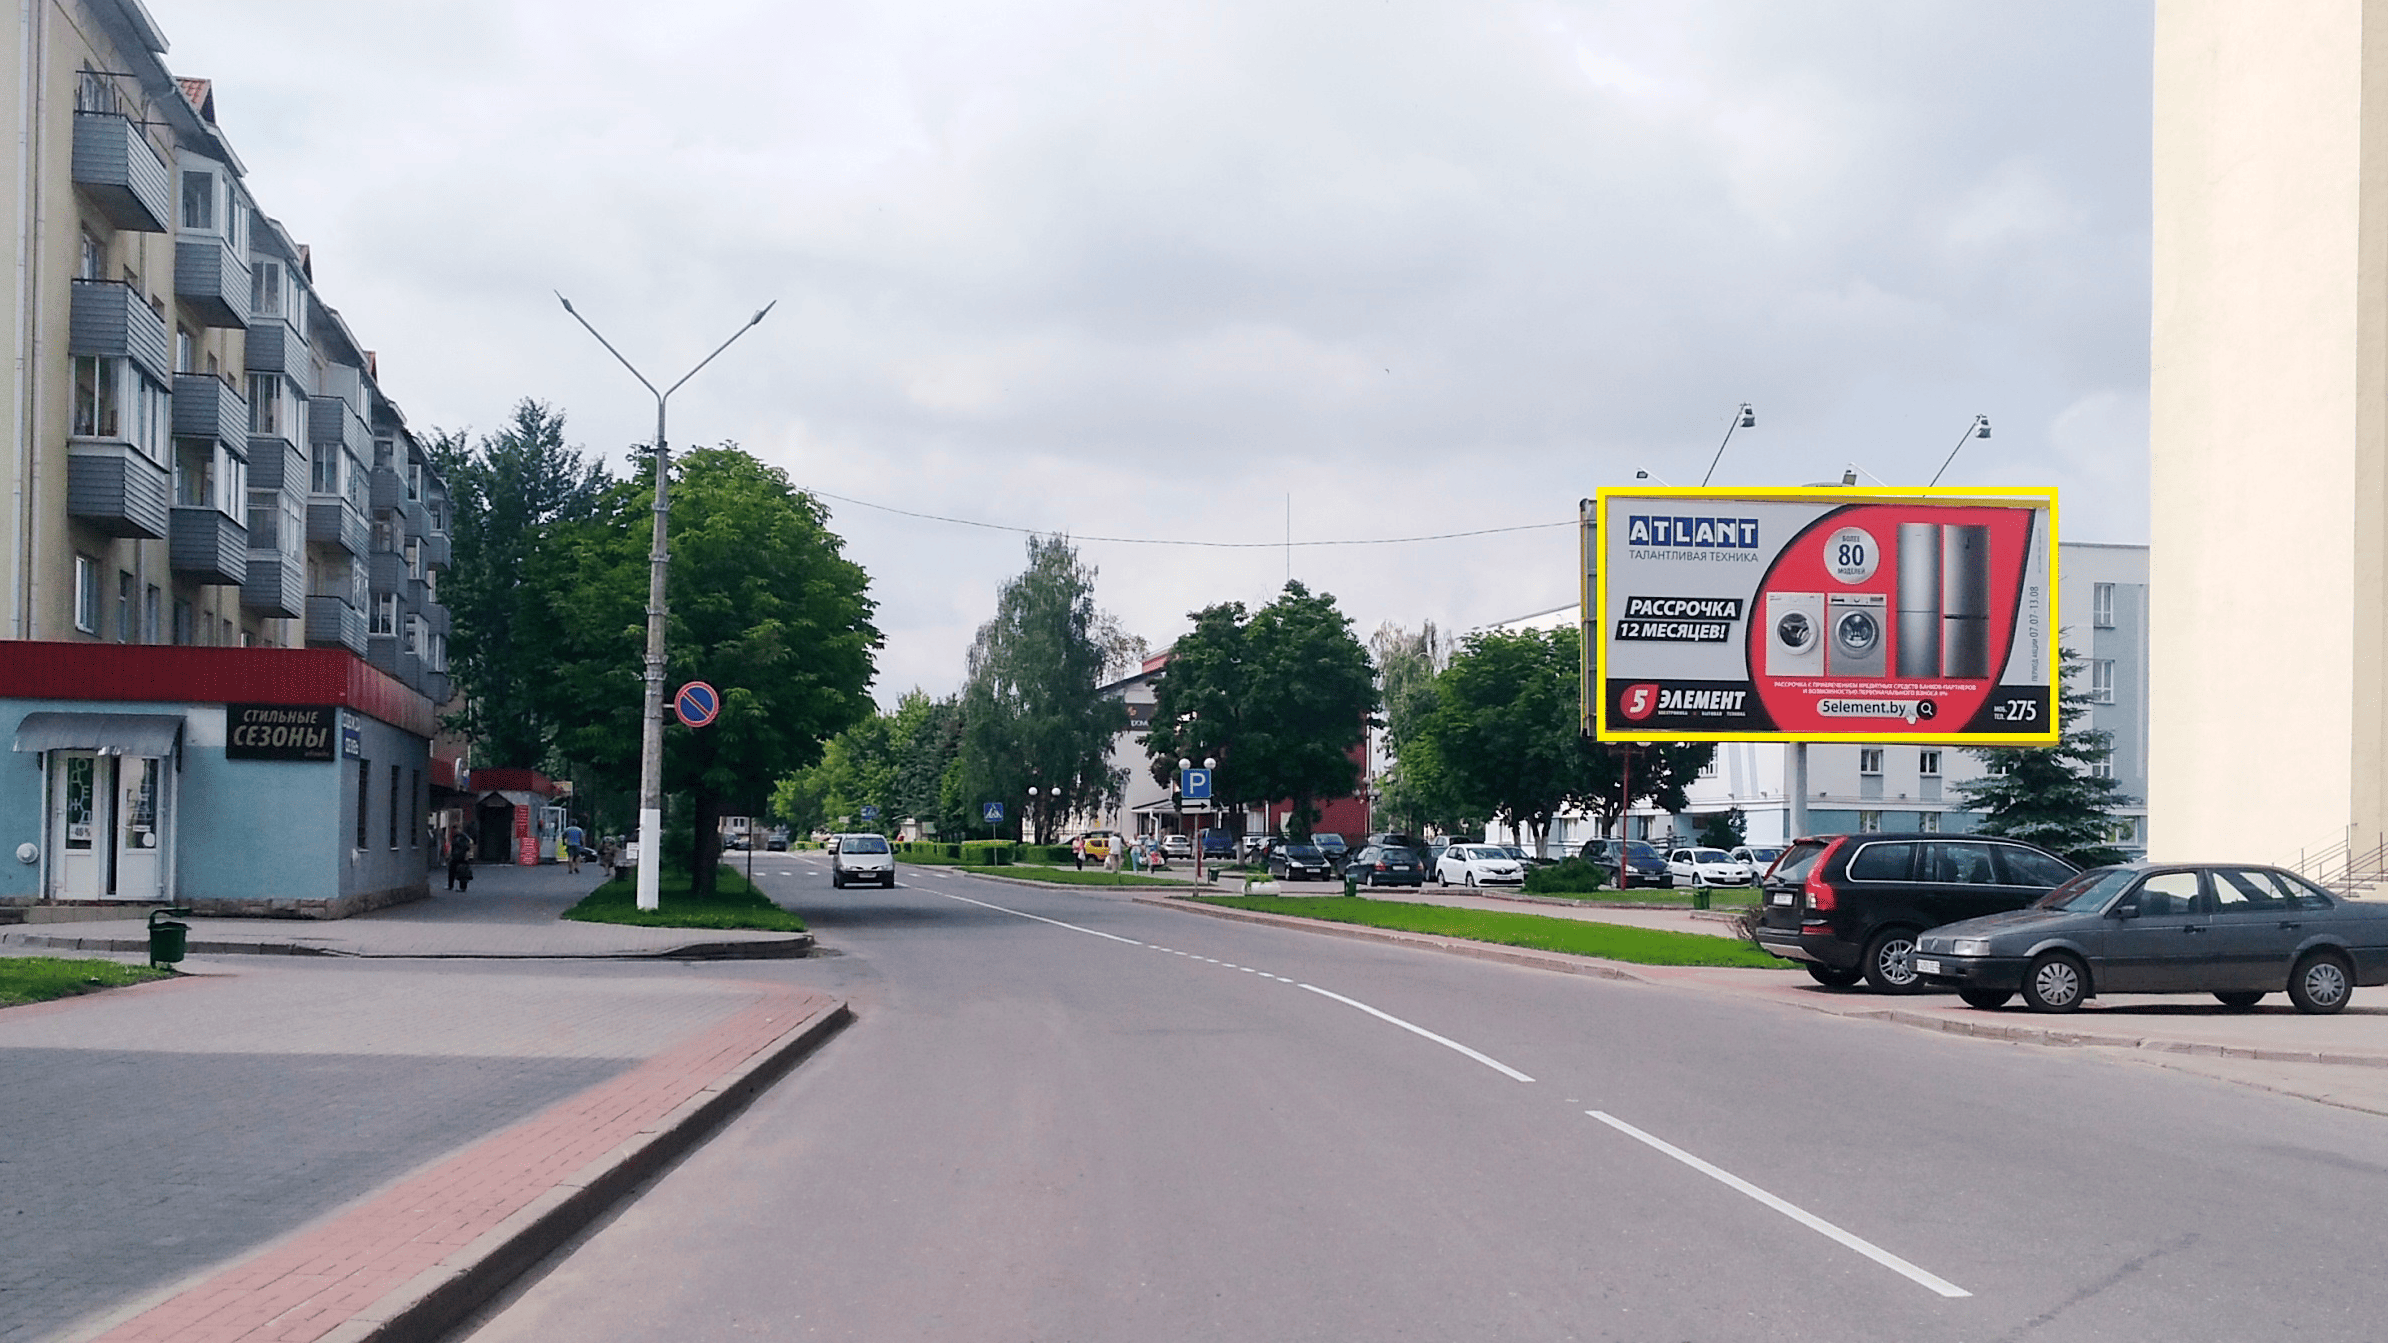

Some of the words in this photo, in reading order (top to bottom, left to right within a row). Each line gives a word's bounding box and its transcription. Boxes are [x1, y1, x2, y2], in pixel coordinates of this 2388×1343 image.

[1629, 519, 1757, 545] ATLANT
[1629, 550, 1707, 562] ТАЛАНТЛИВАЯ
[1710, 551, 1759, 563] ТЕХНИКА
[1838, 544, 1864, 566] 80
[1629, 599, 1736, 617] РАССРОЧКА
[1620, 623, 1640, 637] 12
[1641, 624, 1726, 641] МЕСЯЦЕВ!
[1629, 689, 1649, 713] 5
[1658, 689, 1747, 710] ЭЛЕМЕНТ
[1822, 700, 1906, 717] 5element.by
[2006, 699, 2037, 721] 275
[243, 709, 319, 724] СТИЛЬНЫЕ
[233, 725, 327, 748] СЕЗОНЫ
[1189, 772, 1206, 794] P
